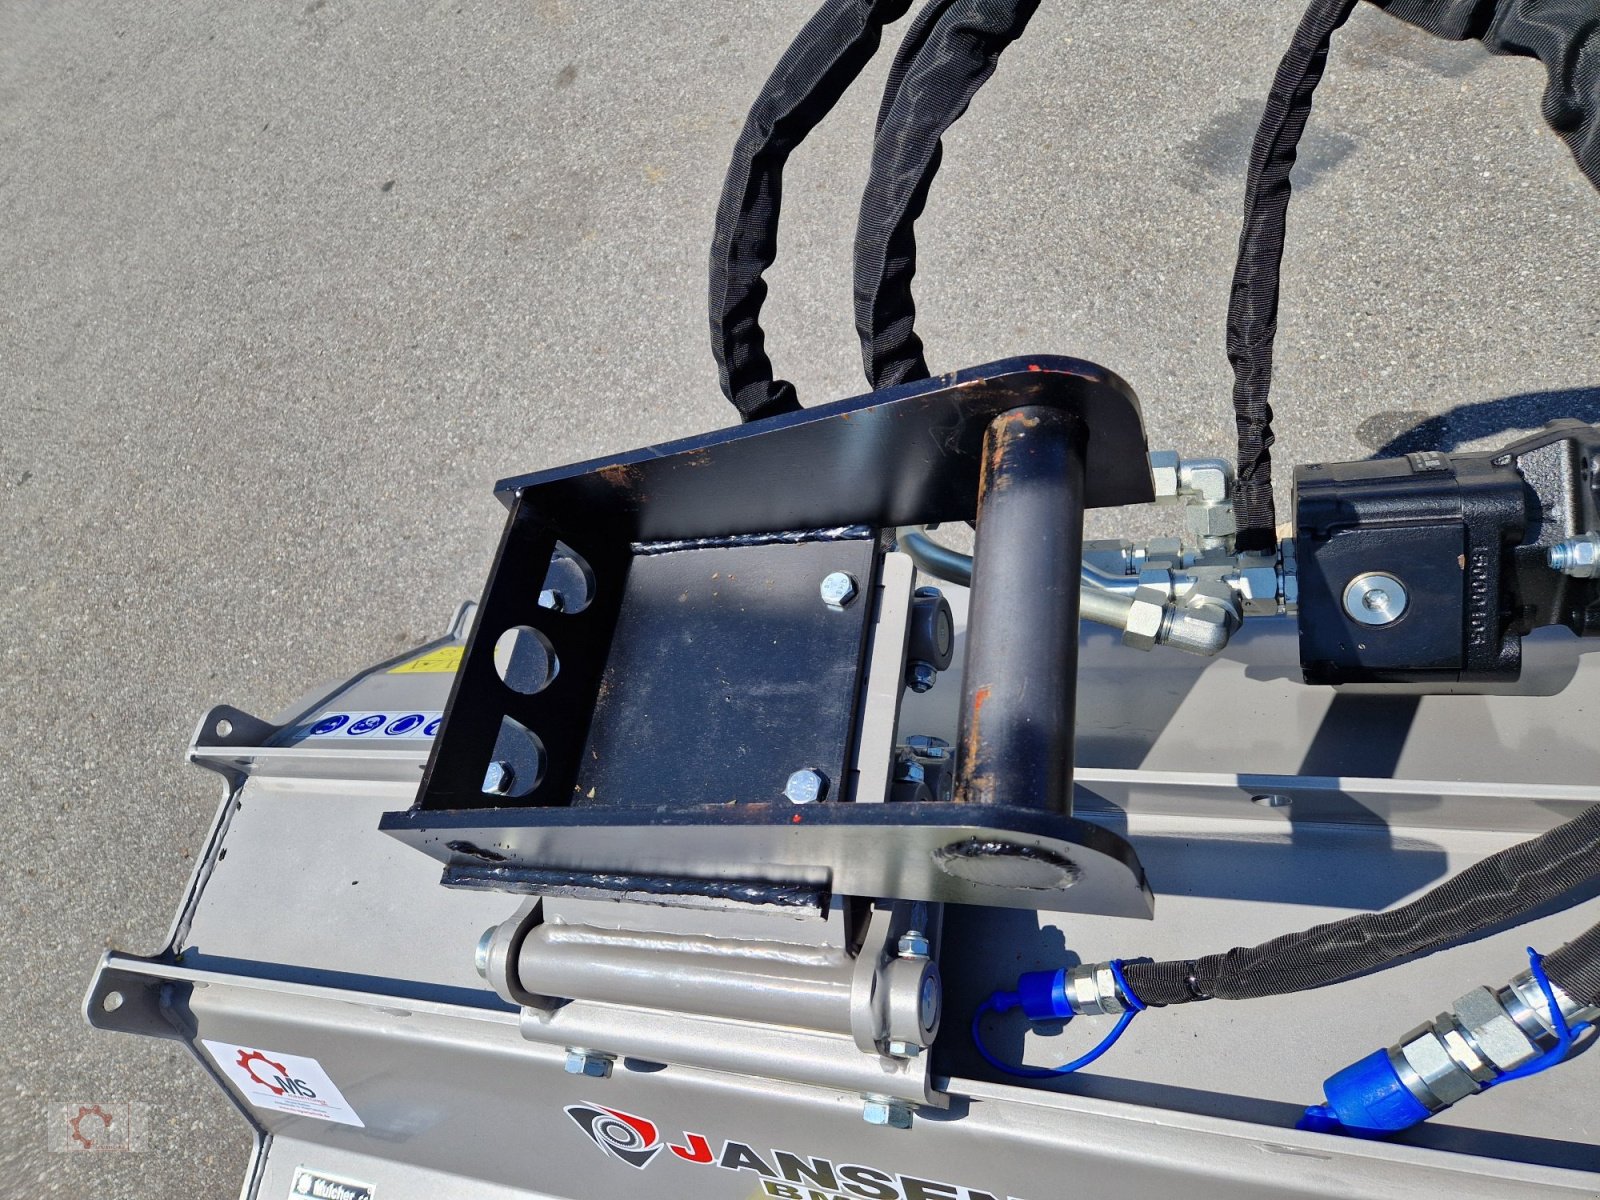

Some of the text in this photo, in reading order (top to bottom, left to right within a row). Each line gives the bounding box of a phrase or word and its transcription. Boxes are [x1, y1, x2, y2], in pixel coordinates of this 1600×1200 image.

[273, 1076, 317, 1098] MS
[670, 1131, 1025, 1200] JANSE
[312, 1179, 356, 1200] Mulcher
